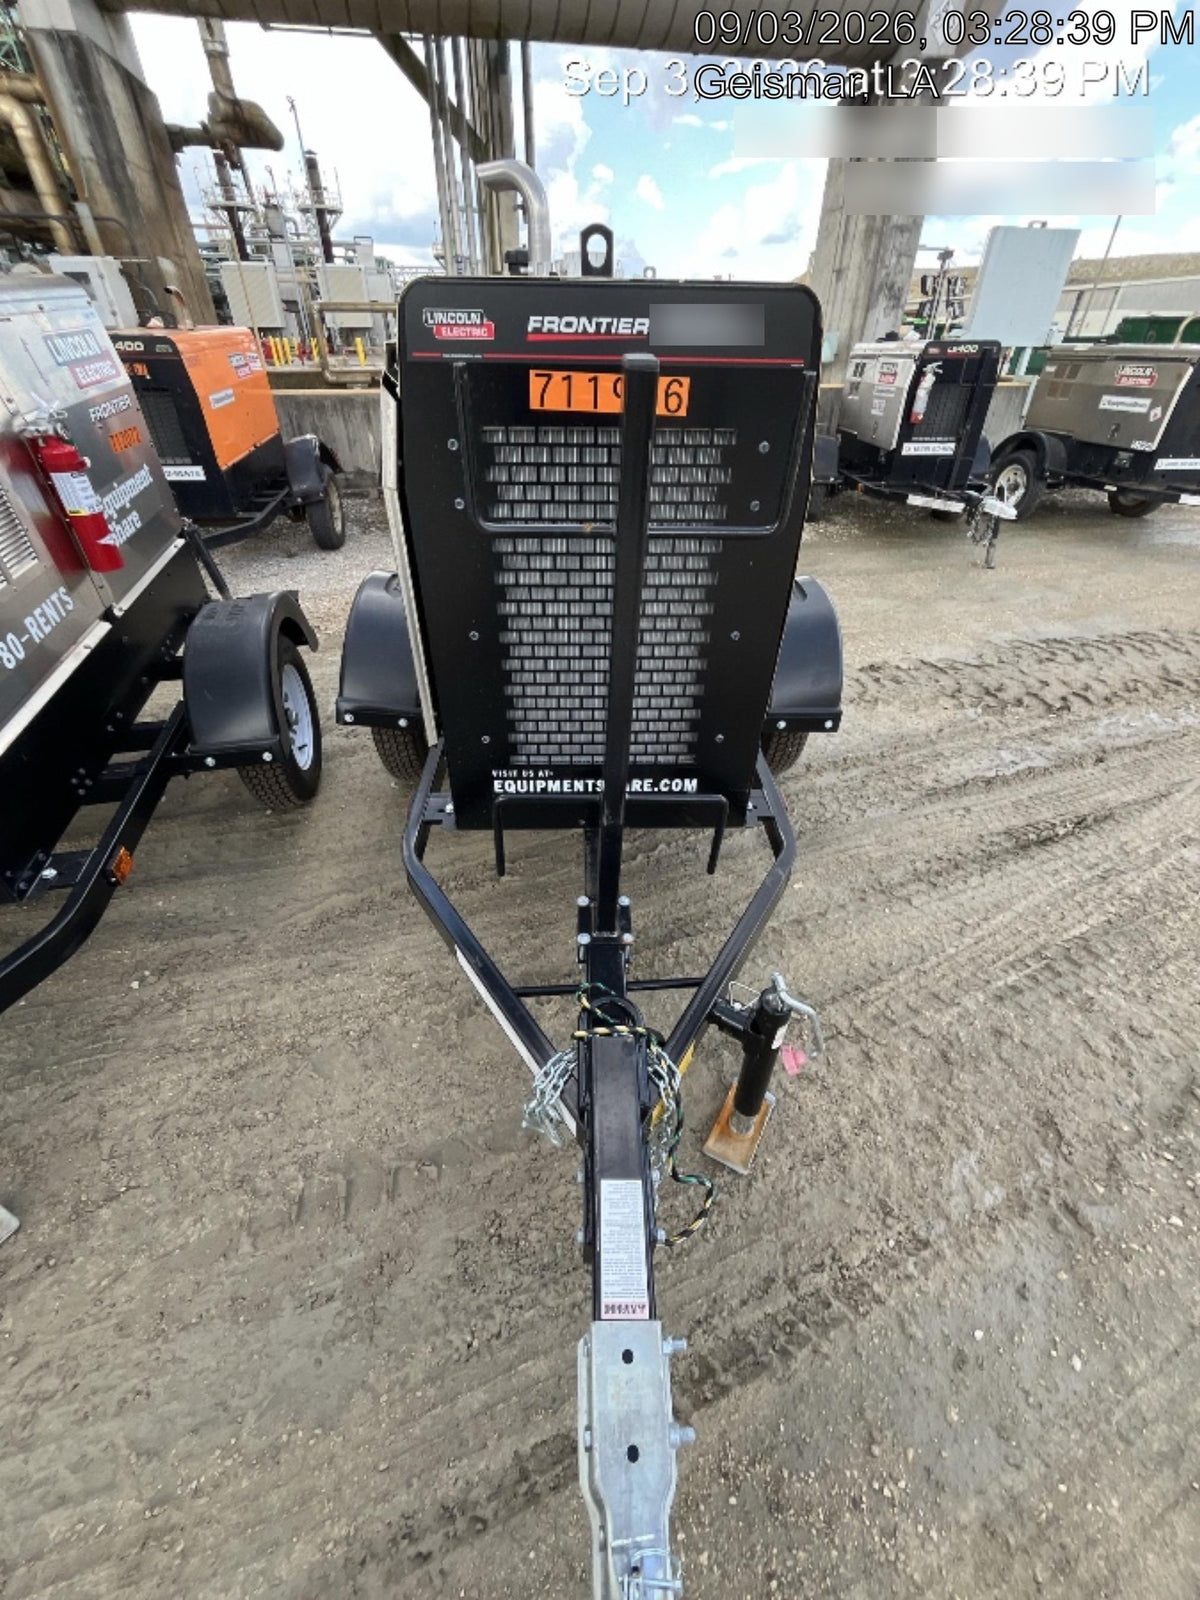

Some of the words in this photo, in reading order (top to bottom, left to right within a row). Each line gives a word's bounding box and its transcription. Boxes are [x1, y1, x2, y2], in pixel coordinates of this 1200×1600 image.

[427, 311, 481, 325] LINCOLN
[527, 315, 649, 335] FRONTIER
[441, 326, 488, 337] ELECTRIC
[47, 332, 103, 363] LINCOLN
[75, 360, 117, 383] ELECTRIC
[534, 373, 684, 414] 7116
[491, 769, 519, 778] VISIT
[521, 769, 534, 778] US
[493, 778, 698, 794] EQUIPMENTSRE.COM
